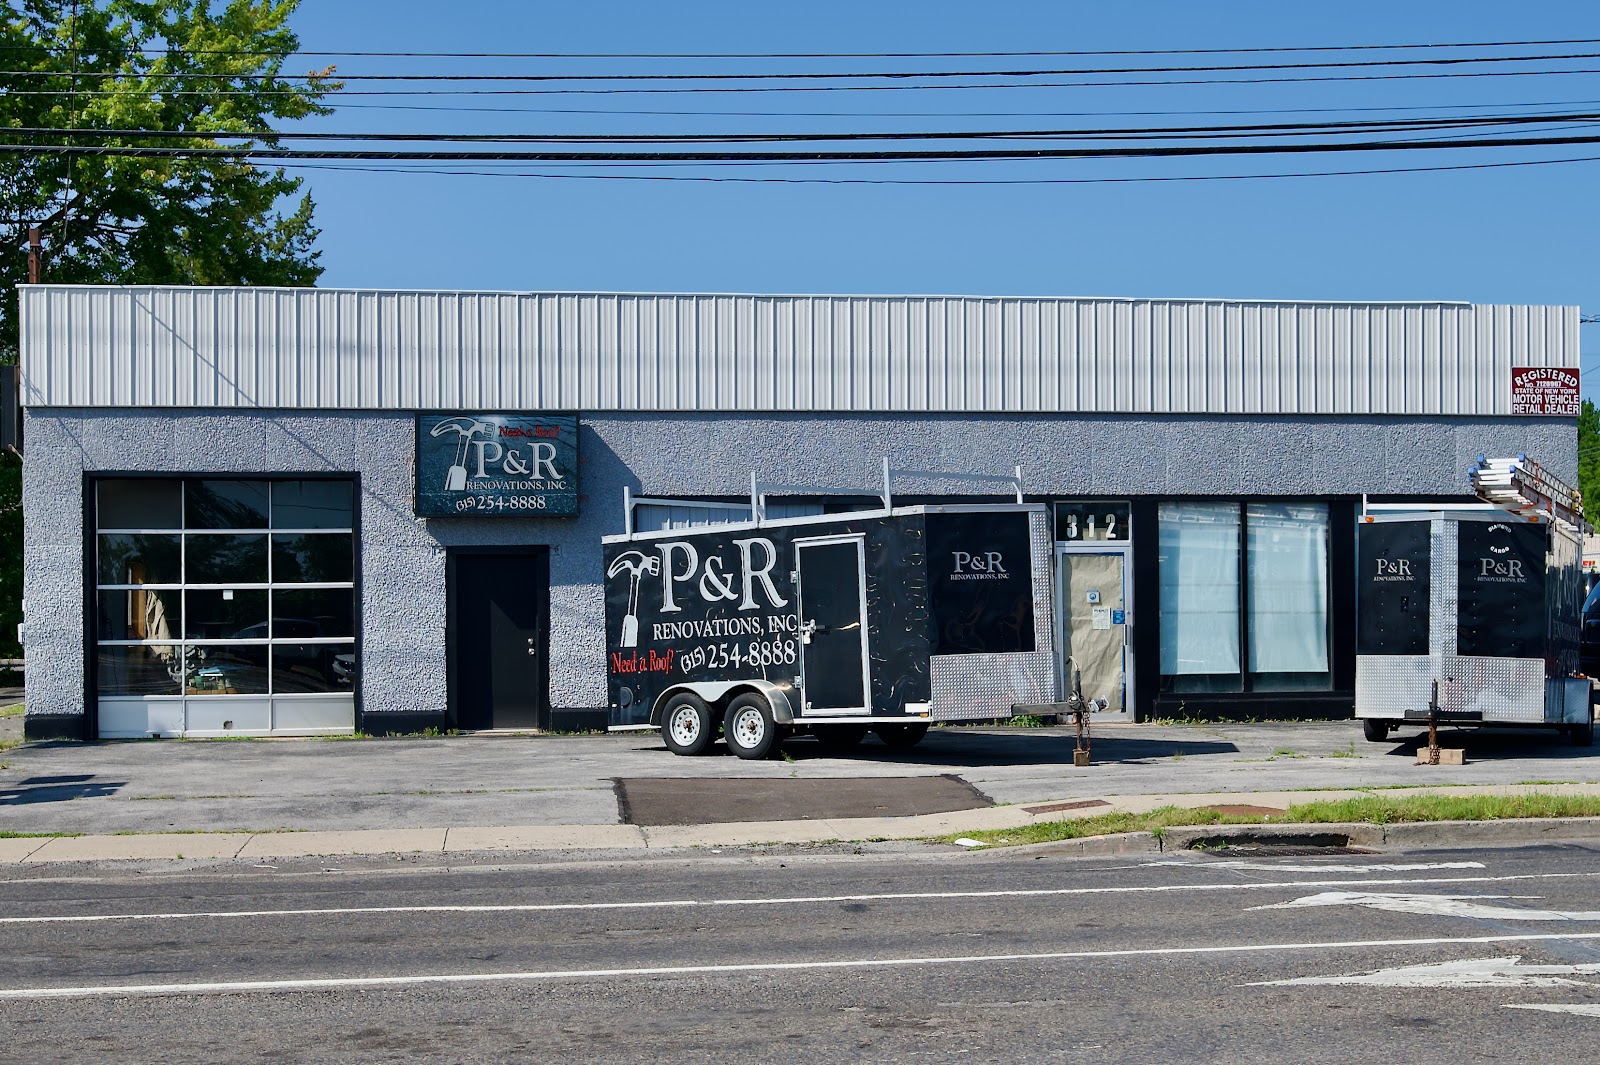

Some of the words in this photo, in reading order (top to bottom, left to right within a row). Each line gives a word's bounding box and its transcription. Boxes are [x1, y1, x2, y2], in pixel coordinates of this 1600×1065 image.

[1515, 369, 1577, 387] REGISTERED
[1513, 394, 1542, 403] MOTOR
[1545, 395, 1579, 404] VEHICLE
[1513, 404, 1543, 413] RETAIL
[1545, 405, 1579, 414] DEALER
[499, 426, 523, 437] Need
[472, 440, 563, 480] P&R
[466, 480, 545, 491] RENOVATIONS,
[547, 481, 567, 490] INC
[455, 496, 476, 511] (315)
[477, 495, 546, 510] 254-8888
[1488, 523, 1512, 533] DIAMOND
[1490, 546, 1510, 554] CARGO
[951, 551, 1007, 573] P&R
[1375, 558, 1412, 575] P&R
[1480, 557, 1525, 578] P&R
[655, 538, 788, 613] P&R
[653, 617, 765, 641] RENOVATIONS,
[768, 614, 798, 633] INC
[611, 650, 637, 673] Need
[639, 657, 647, 672] a
[649, 648, 674, 675] Roof?
[680, 645, 706, 674] (315)
[706, 641, 796, 669] 254-8888
